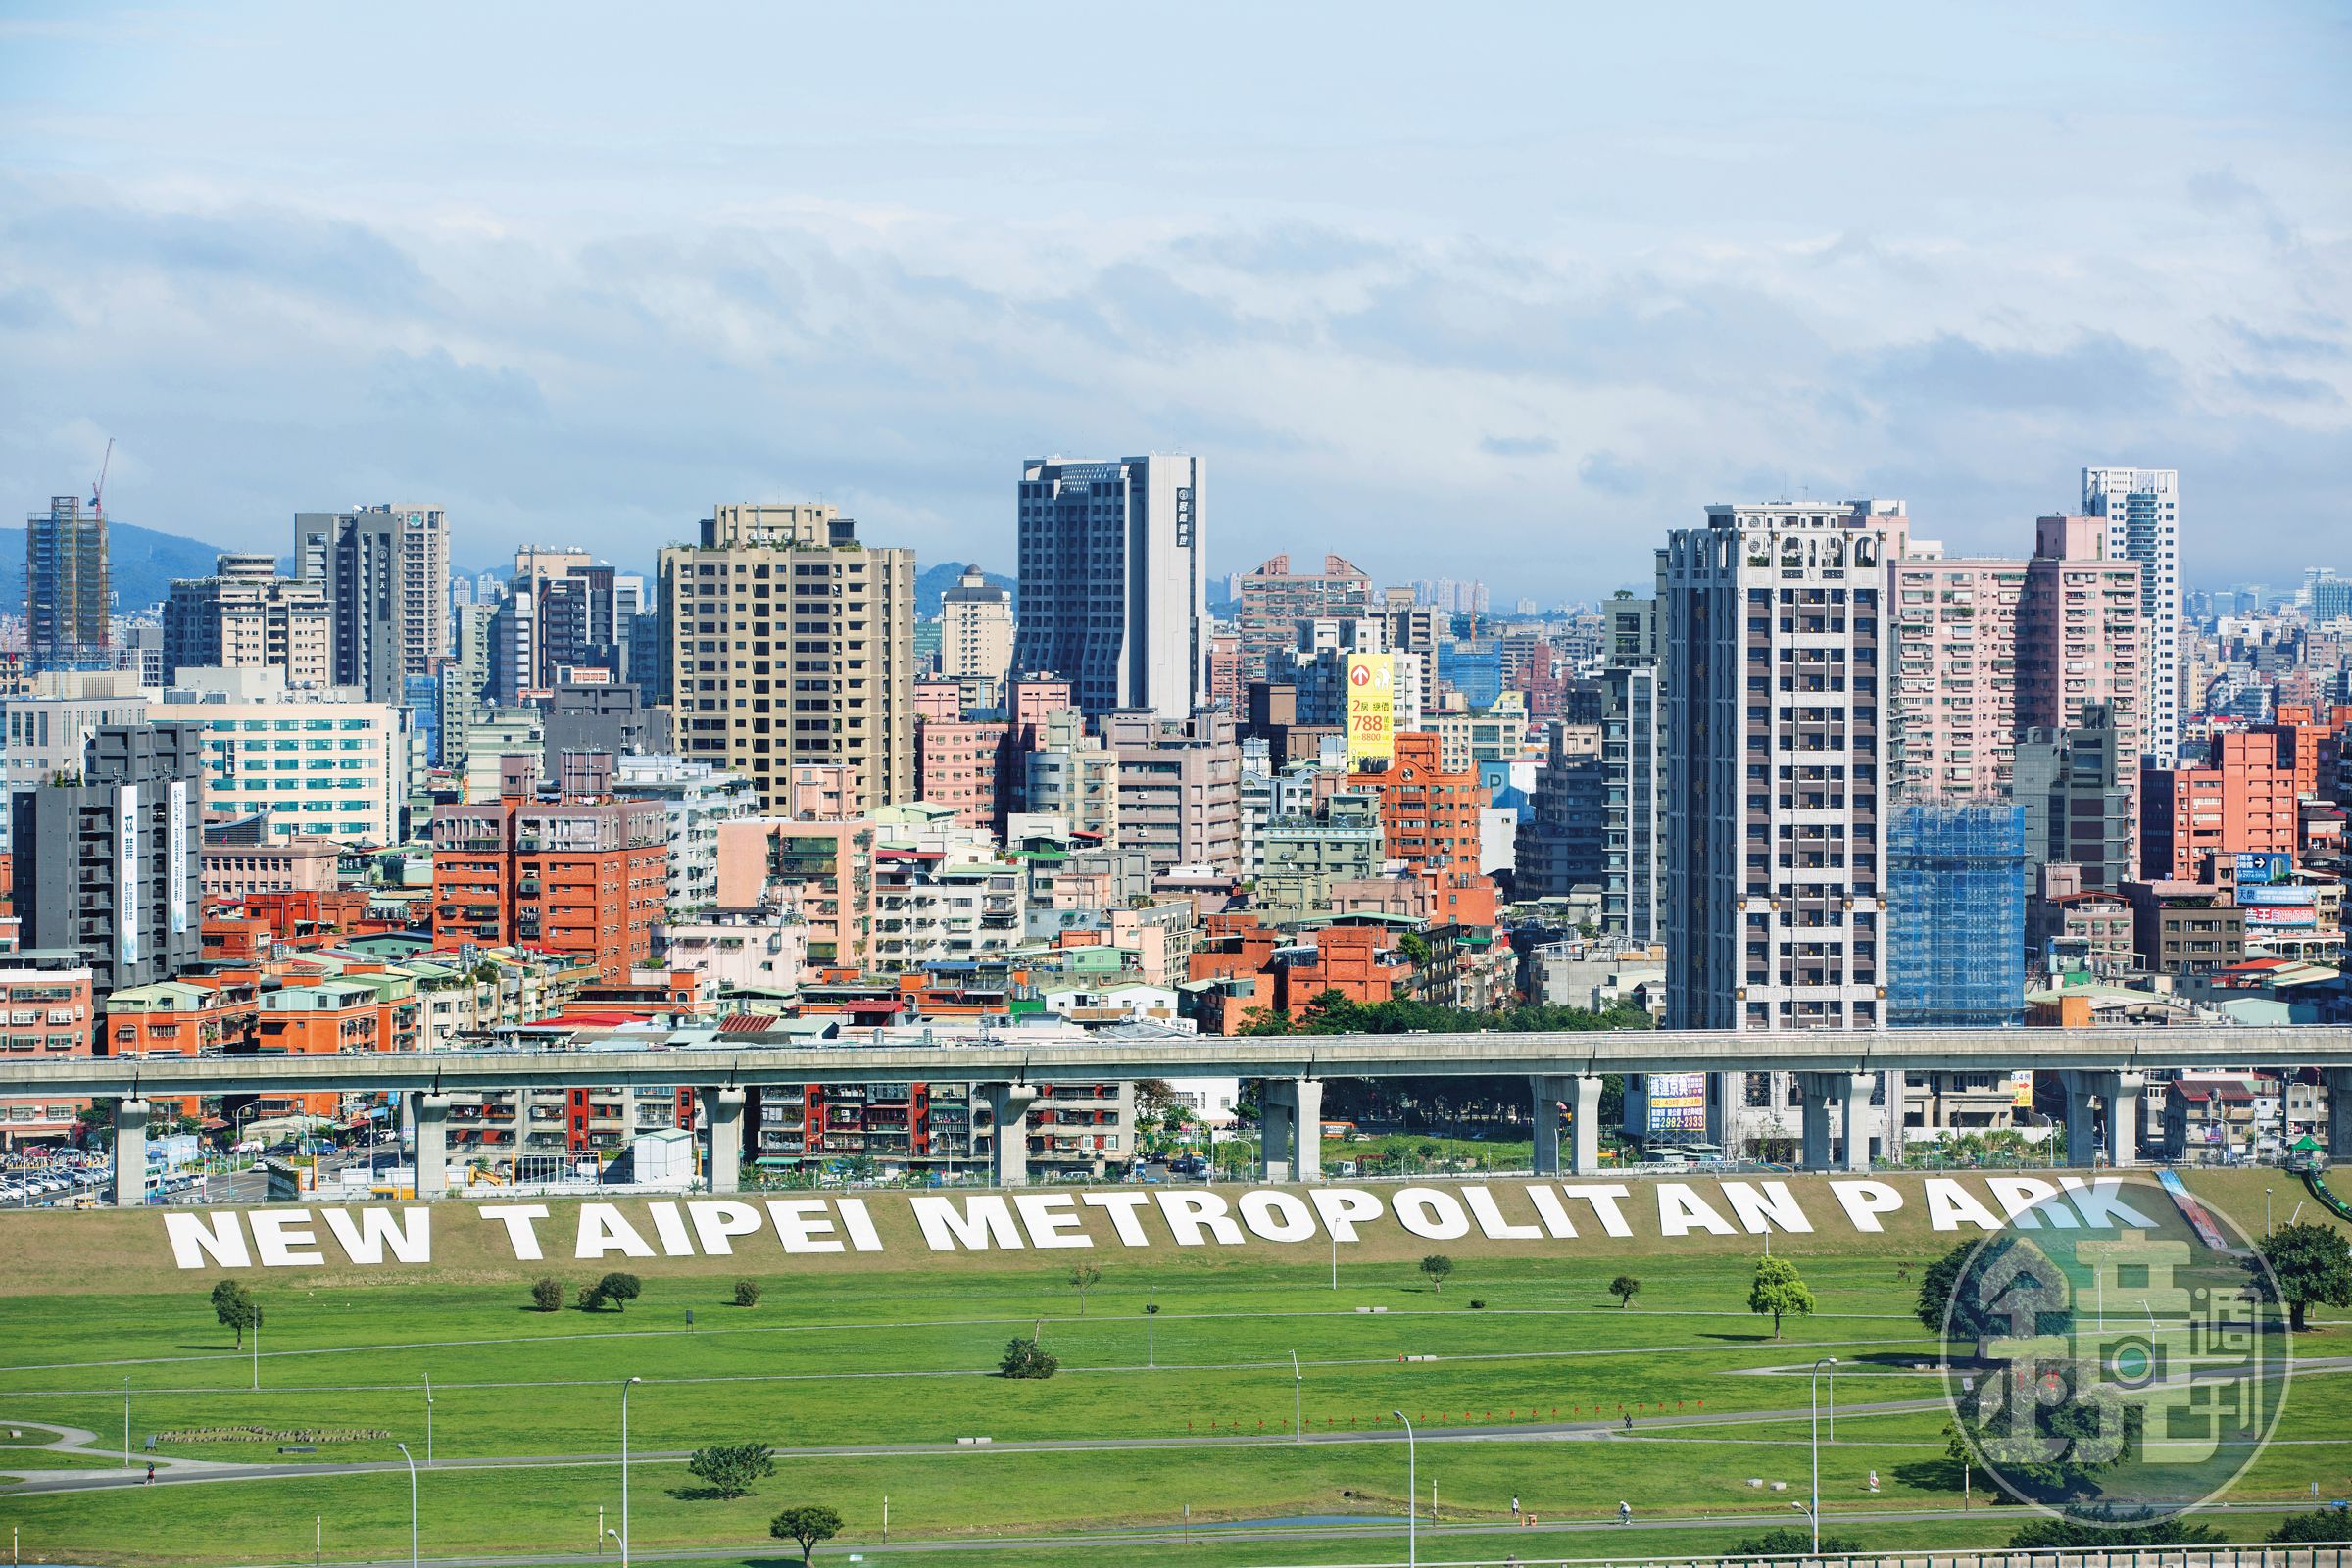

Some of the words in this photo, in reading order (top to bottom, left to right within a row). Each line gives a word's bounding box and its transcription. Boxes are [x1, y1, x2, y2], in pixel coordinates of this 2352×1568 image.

[1352, 715, 1383, 732] 788
[1490, 774, 1502, 789] P
[1660, 1115, 1704, 1128] 2982-2333
[163, 1205, 431, 1269] NEW
[477, 1197, 884, 1261] TAIPEI
[908, 1180, 1815, 1252] METROPOLITAN
[1828, 1176, 2162, 1233] PARK
